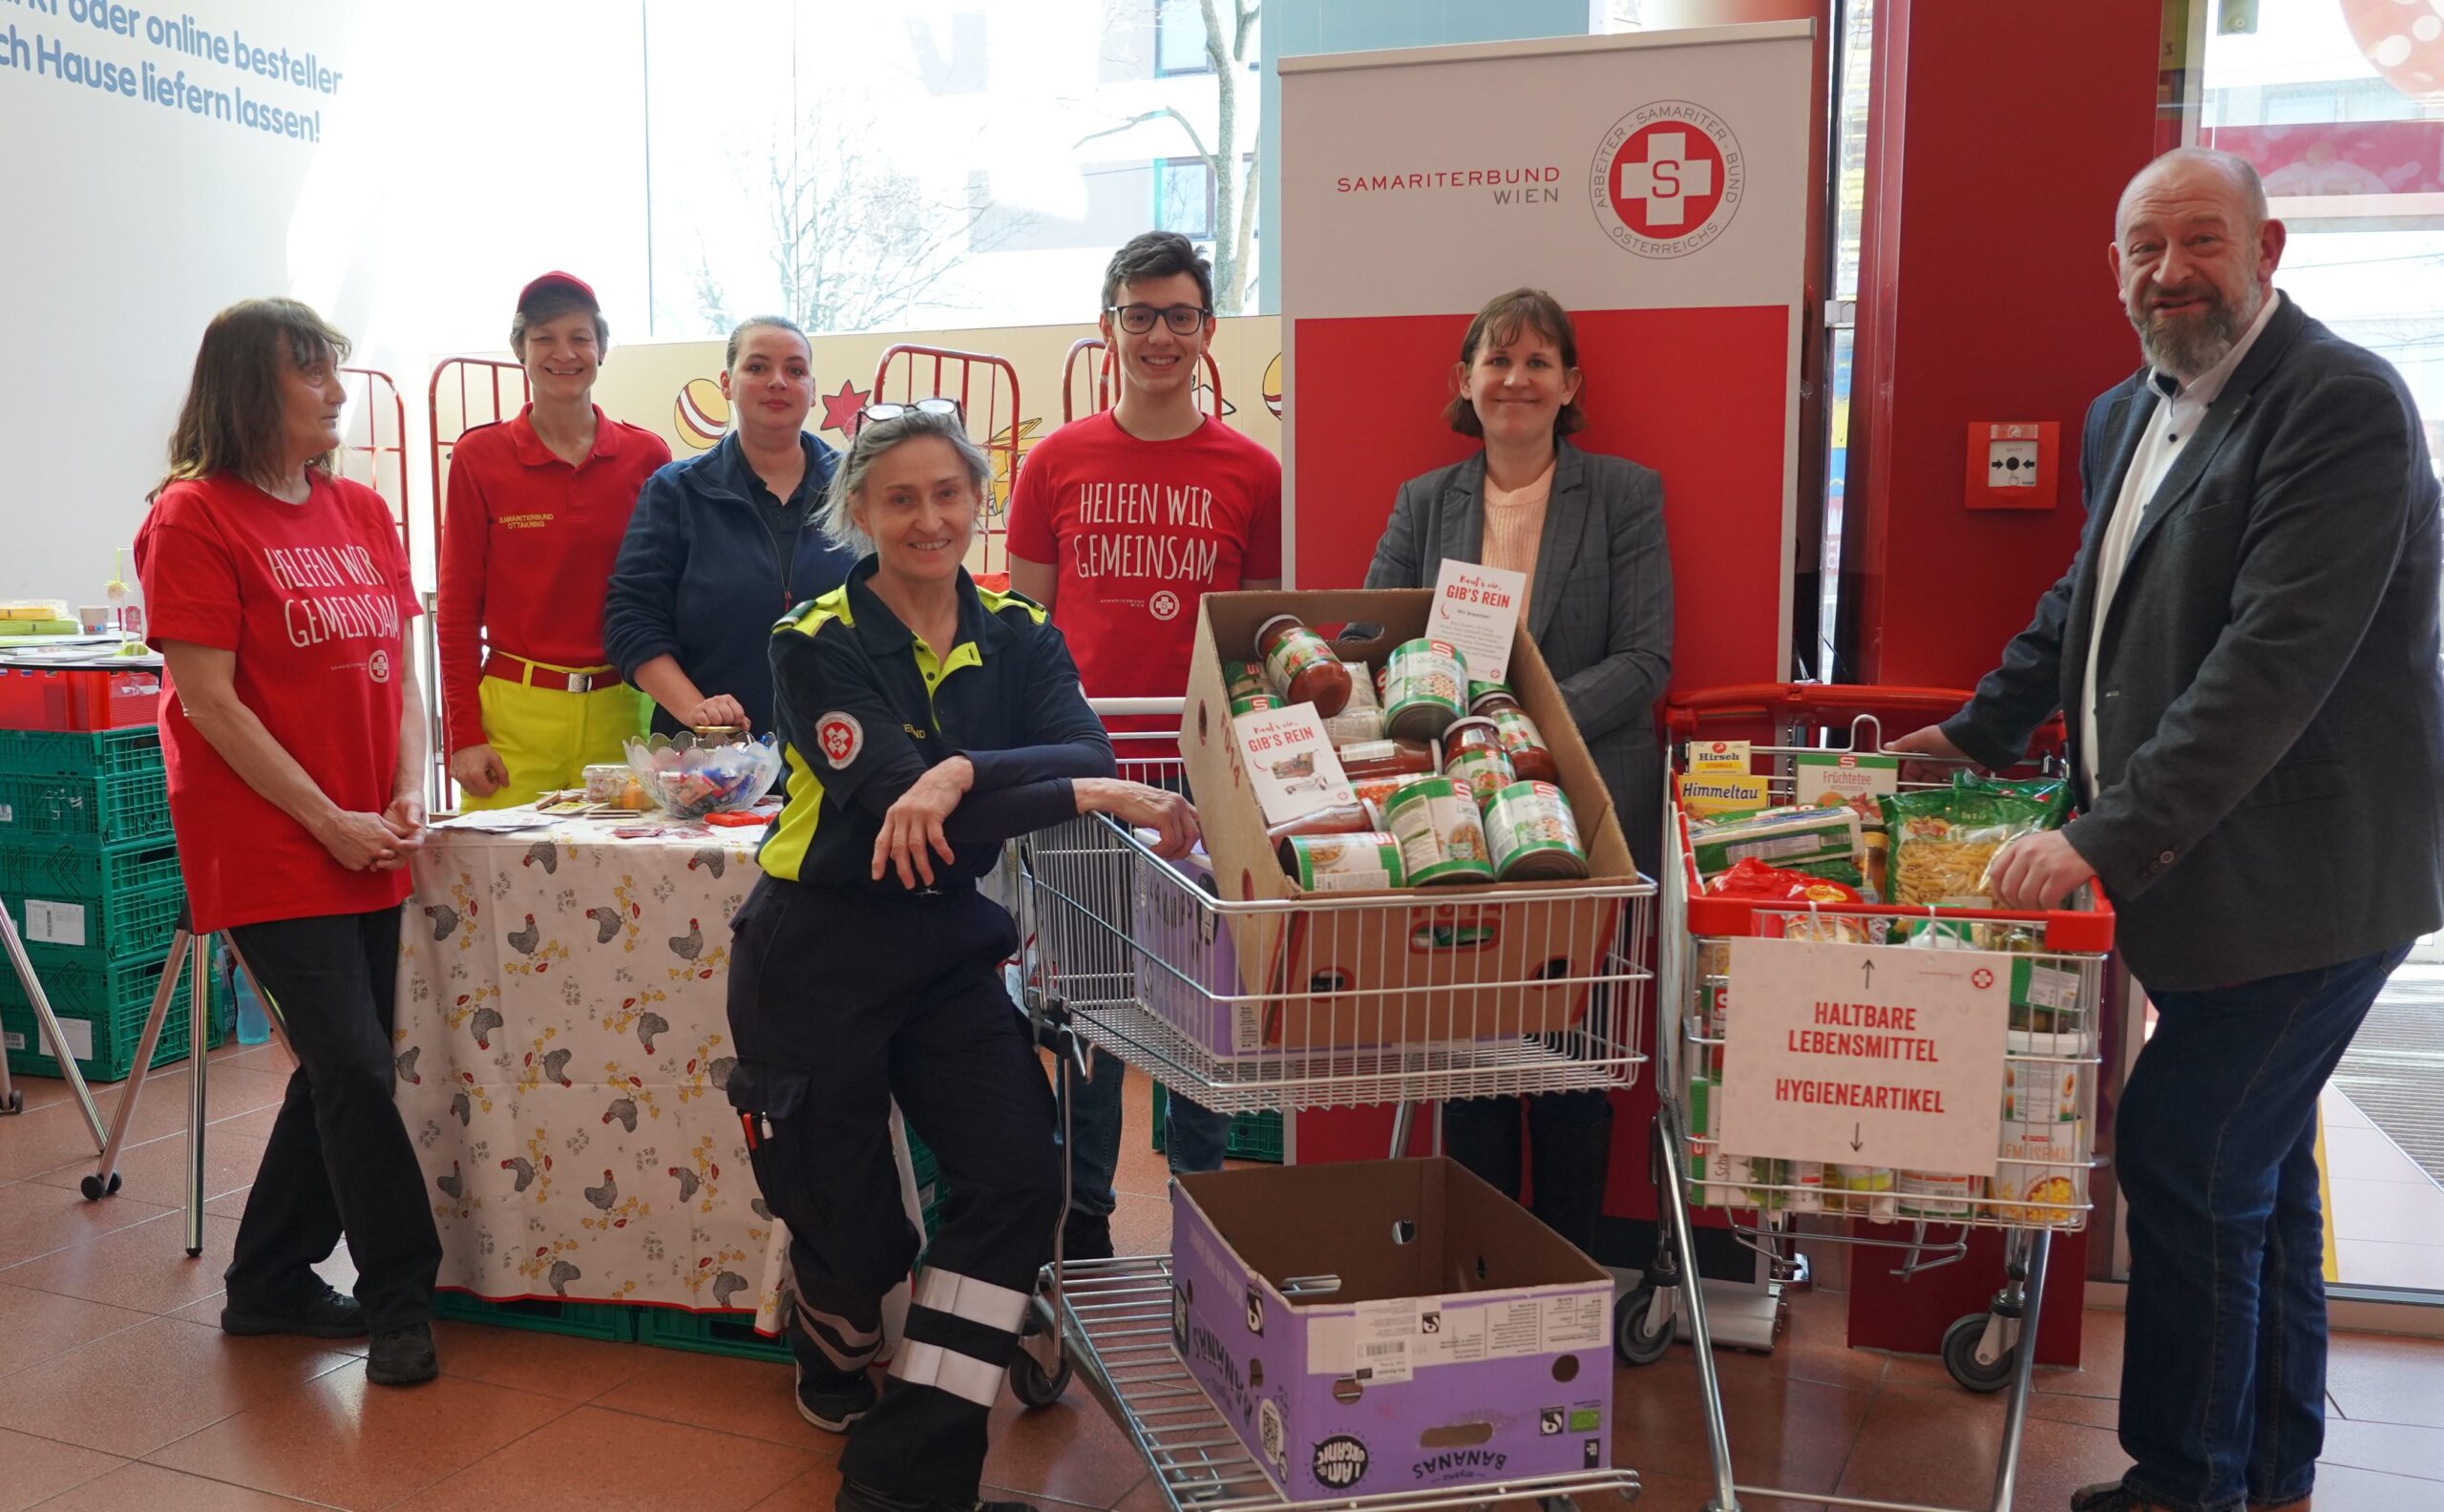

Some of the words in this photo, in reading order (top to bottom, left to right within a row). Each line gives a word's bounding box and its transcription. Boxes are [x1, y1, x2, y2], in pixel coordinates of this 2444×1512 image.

[68, 0, 140, 37] oder
[146, 13, 229, 64] online
[36, 34, 137, 97] Hause
[141, 60, 232, 122] liefern
[235, 87, 320, 144] lassen!
[1337, 167, 1560, 193] SAMARITERBUND
[1652, 159, 1680, 199] S
[1493, 188, 1559, 205] WIEN
[1080, 482, 1159, 525] HELFEN
[1167, 485, 1213, 530] WIR
[263, 546, 346, 590] HELFEN
[331, 543, 385, 585] WIR
[1073, 534, 1218, 585] GEMEINSAM
[1446, 584, 1479, 603] GIB'S
[1481, 591, 1510, 609] REIN
[284, 594, 401, 648] GEMEINSAM
[1248, 734, 1283, 752] GIB'S
[1284, 726, 1315, 745] REIN
[1698, 752, 1740, 761] Hirsch
[1682, 783, 1759, 800] Himmeltau
[1822, 771, 1872, 785] Früchtetee
[1814, 1000, 1917, 1031] HALTBARE
[1787, 1030, 1939, 1062] LEBENSMITTEL
[1775, 1078, 1946, 1113] HYGIENEARTIKEL
[1317, 1441, 1365, 1464] ORGANIC
[1412, 1449, 1506, 1479] BANANAS
